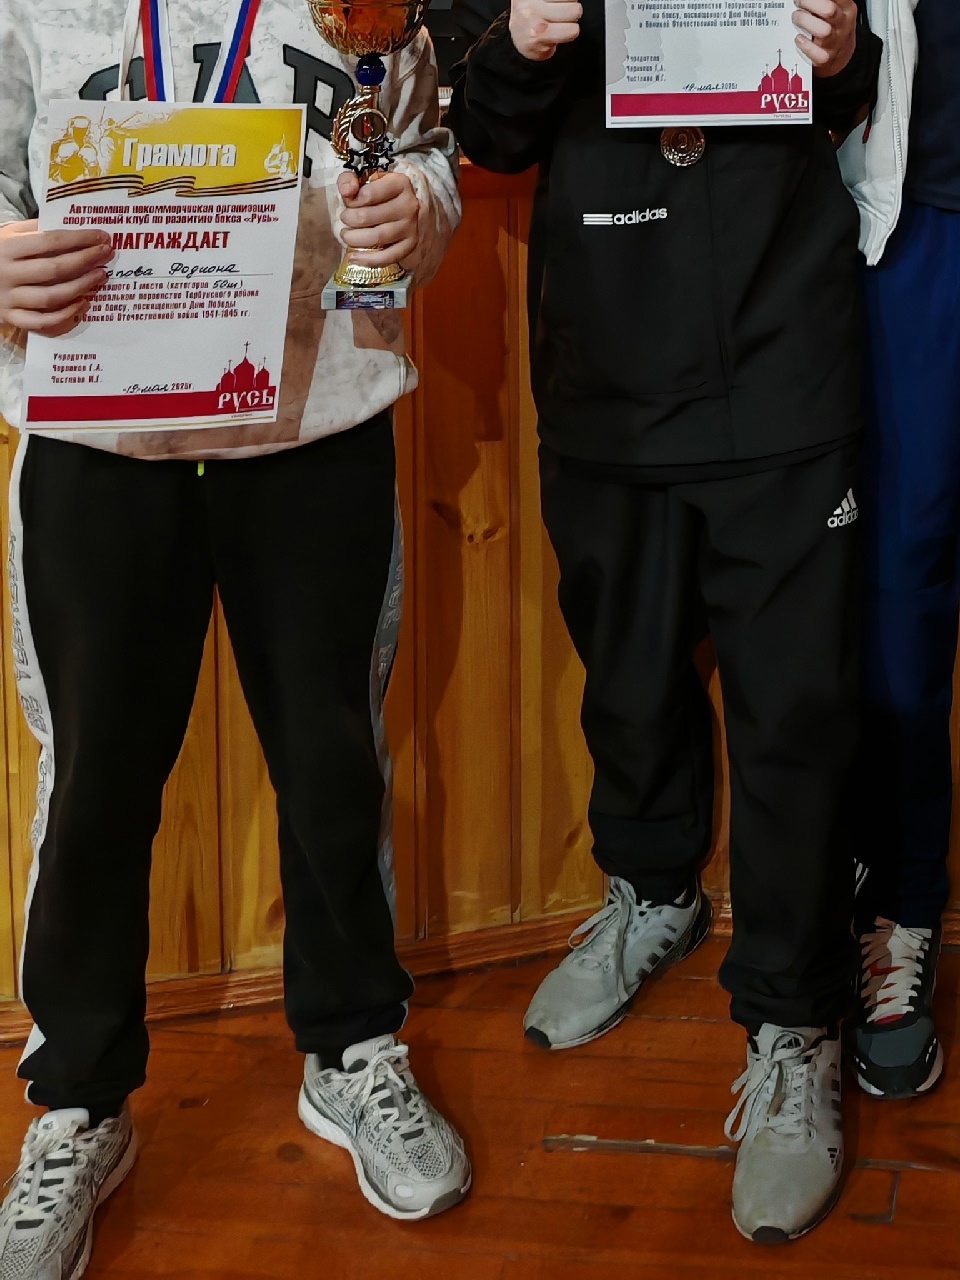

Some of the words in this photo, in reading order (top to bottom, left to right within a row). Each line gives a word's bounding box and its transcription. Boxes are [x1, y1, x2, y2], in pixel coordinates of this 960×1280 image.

[122, 138, 237, 171] Грамота
[69, 204, 130, 214] Автономная
[216, 204, 276, 214] организация
[614, 208, 667, 224] adidas
[63, 214, 124, 226] спортивный
[125, 214, 149, 225] клуб
[152, 215, 163, 224] по
[165, 214, 213, 224] развитию
[215, 214, 242, 223] бокса
[112, 231, 231, 252] НАГРАЖДАЕТ
[95, 265, 153, 278] опова
